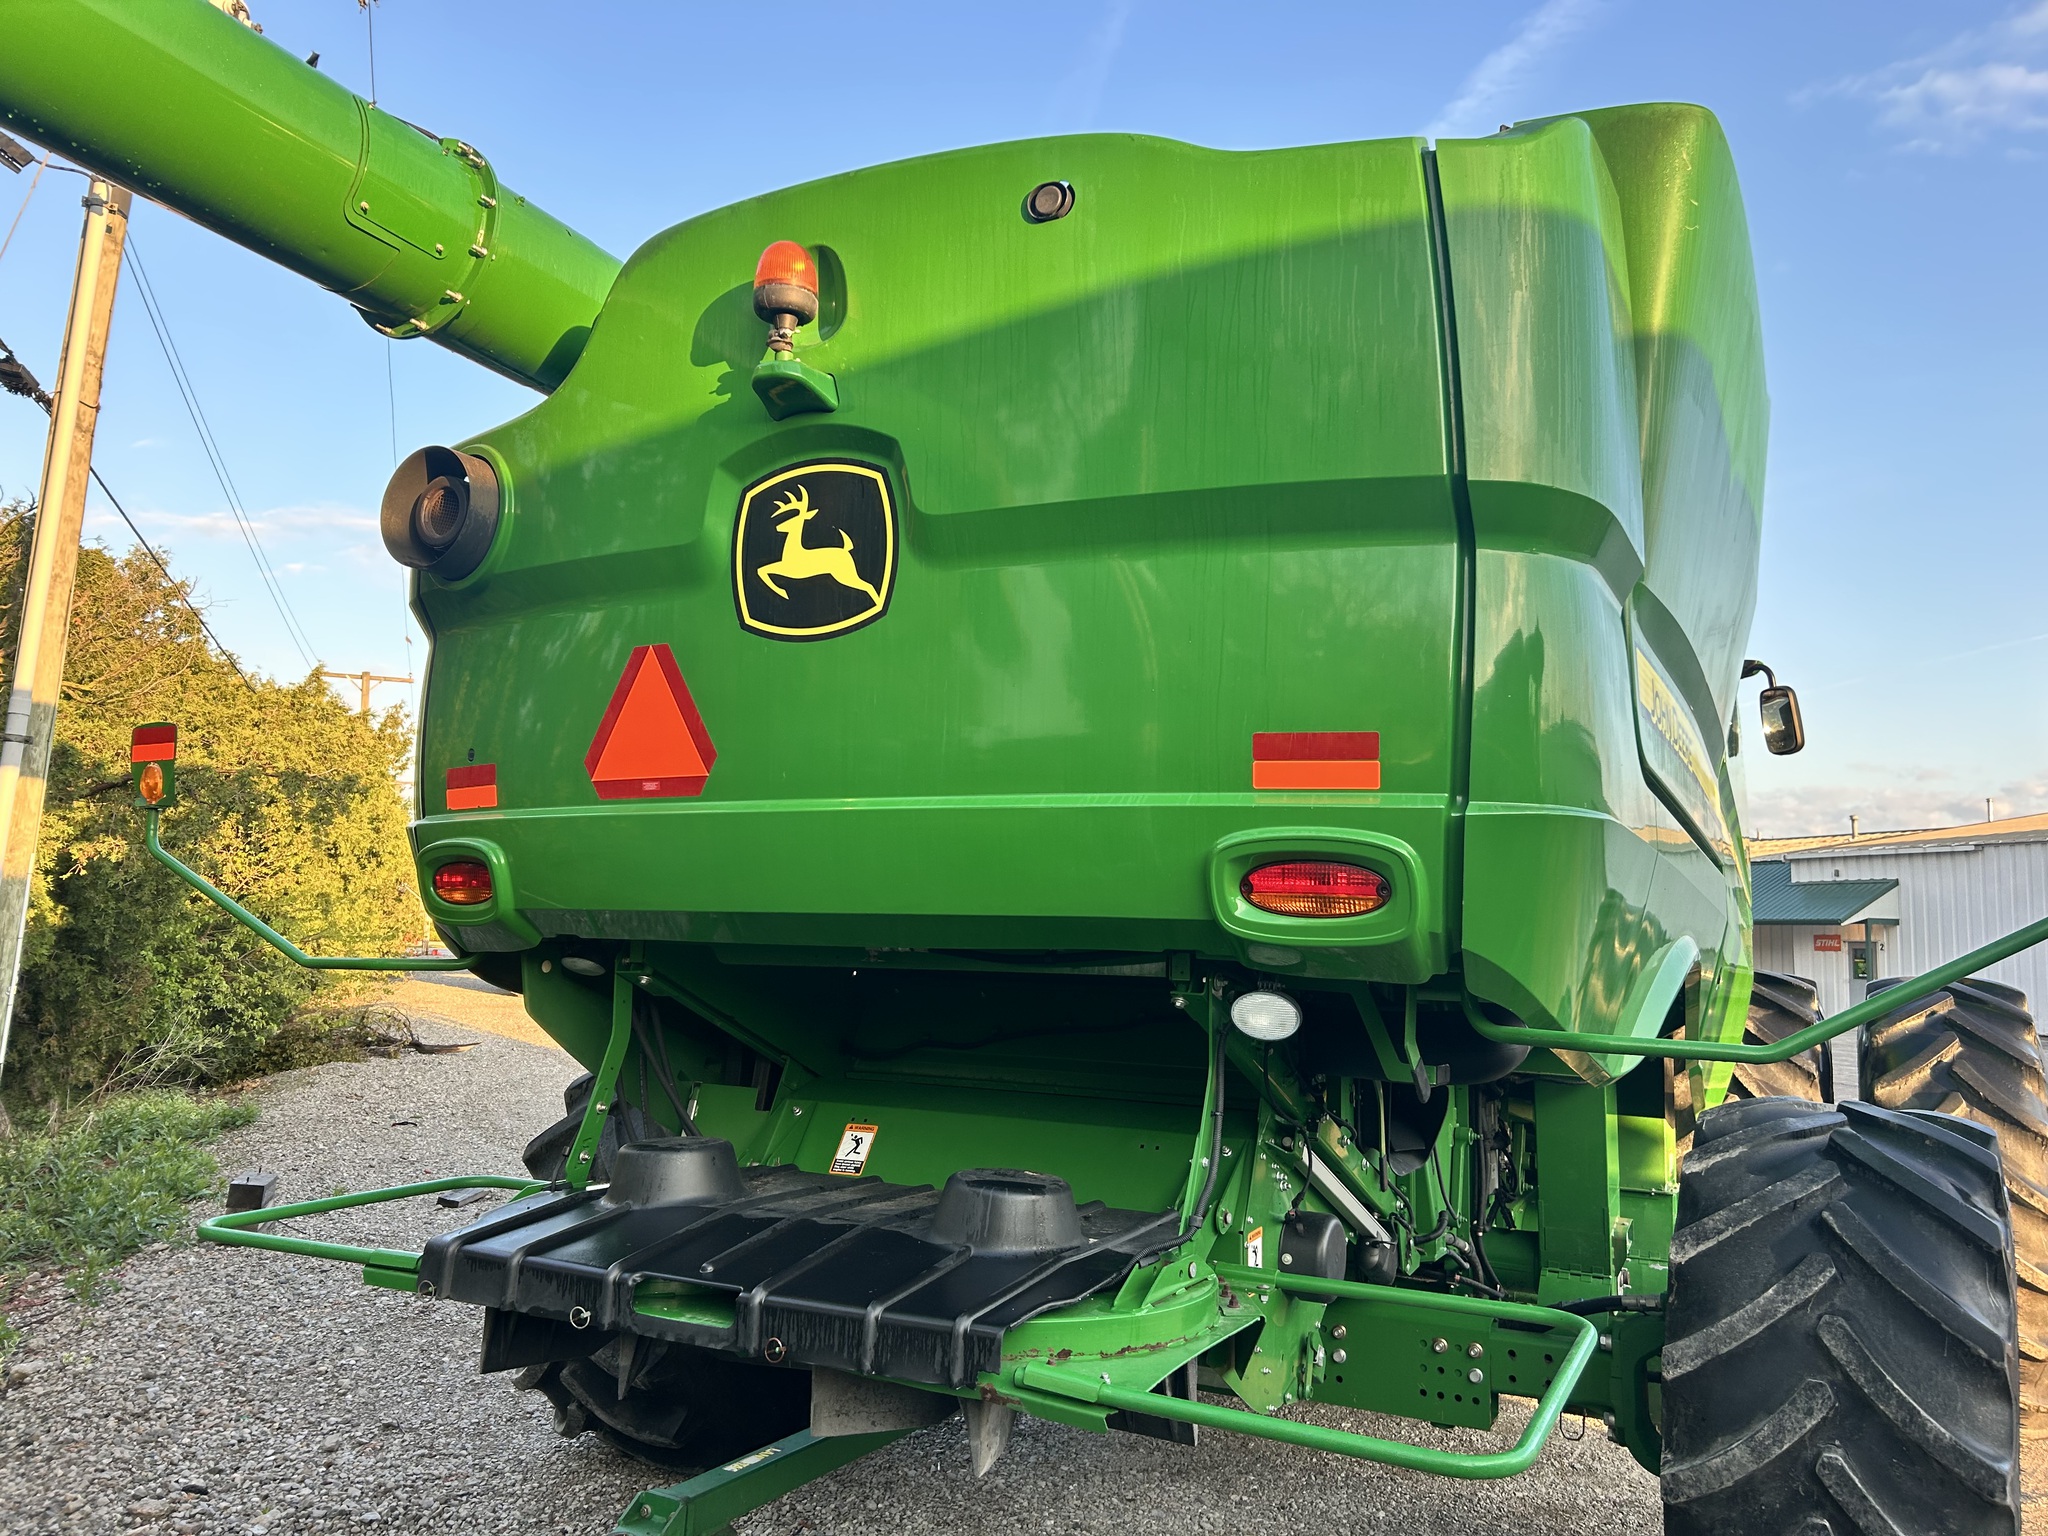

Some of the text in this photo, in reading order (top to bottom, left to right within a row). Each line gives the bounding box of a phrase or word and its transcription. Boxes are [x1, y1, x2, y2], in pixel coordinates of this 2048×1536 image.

[1651, 678, 1672, 741] JOHN
[1815, 939, 1840, 947] STIHL
[1879, 943, 1885, 951] 2
